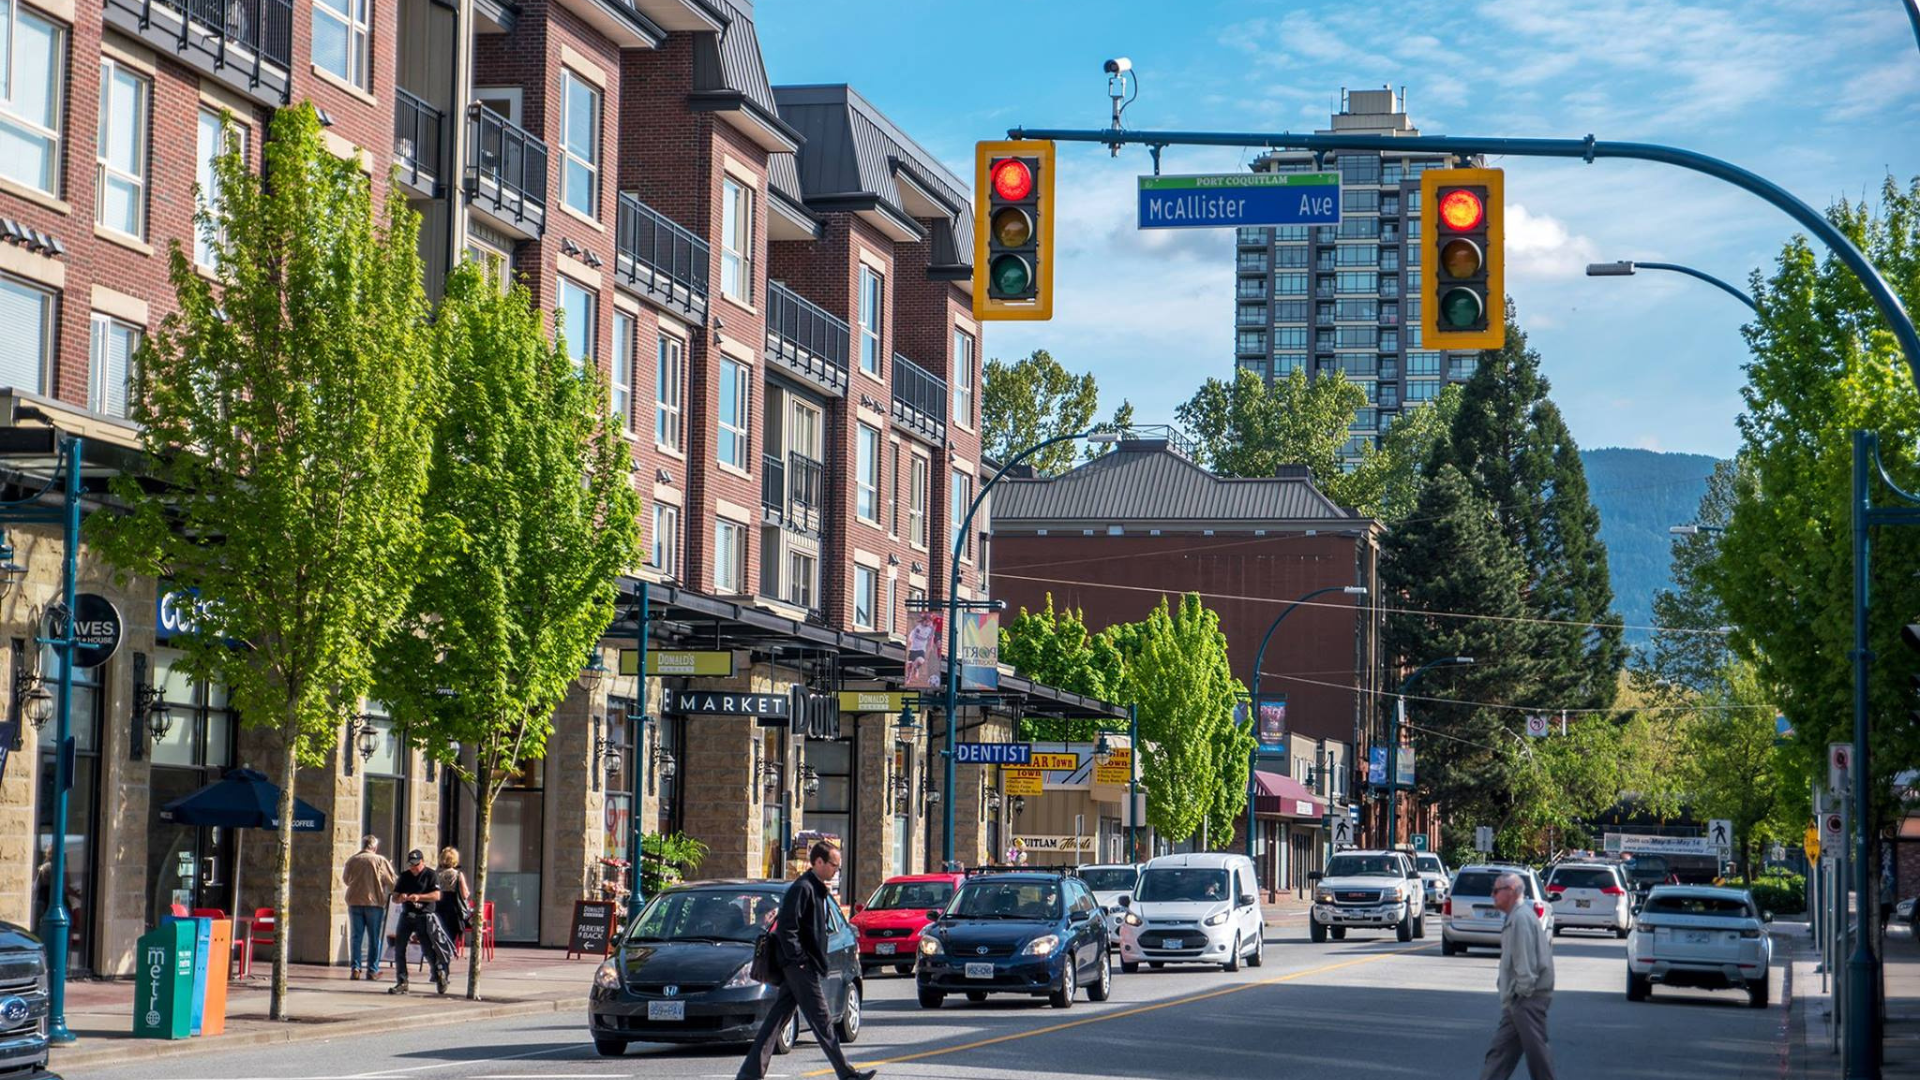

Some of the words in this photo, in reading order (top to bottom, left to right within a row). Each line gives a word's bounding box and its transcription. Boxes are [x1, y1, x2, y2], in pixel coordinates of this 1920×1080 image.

[1196, 177, 1223, 187] PORT
[1225, 176, 1288, 186] COQUITLAM
[1149, 195, 1245, 220] McAllister
[1299, 194, 1332, 216] Ave
[88, 636, 113, 644] HOUSE
[680, 695, 783, 714] MARKET
[958, 744, 1029, 763] DENTIST
[1415, 836, 1424, 849] P
[578, 924, 605, 933] PARKING
[582, 932, 603, 940] BACK
